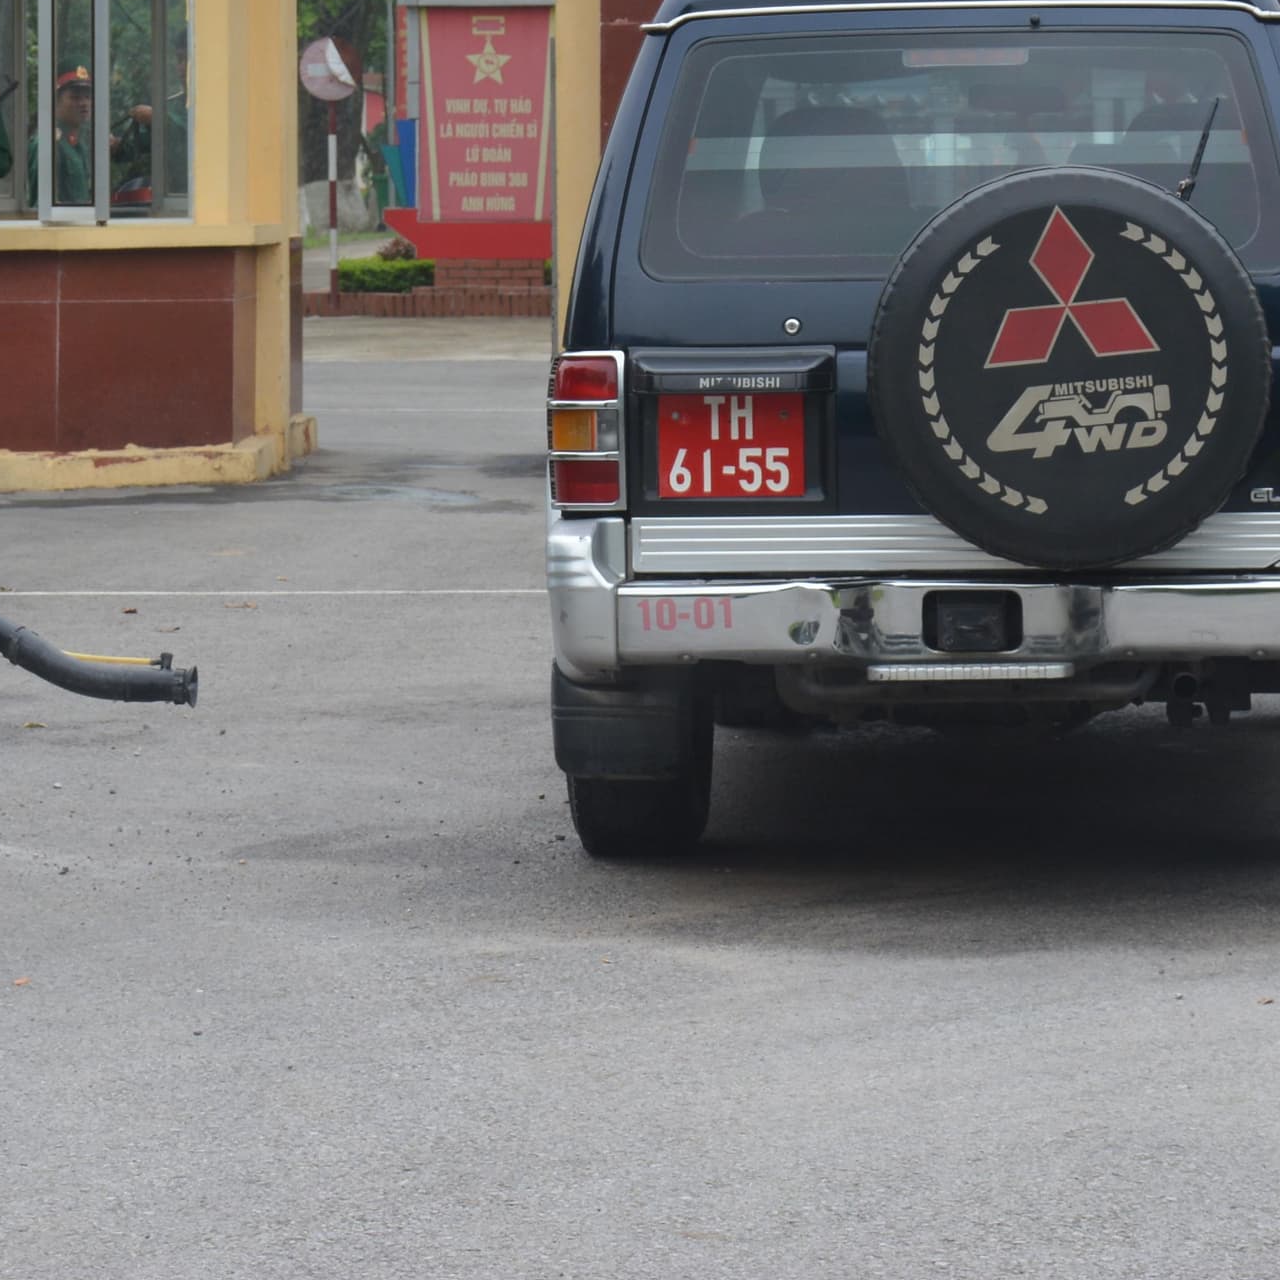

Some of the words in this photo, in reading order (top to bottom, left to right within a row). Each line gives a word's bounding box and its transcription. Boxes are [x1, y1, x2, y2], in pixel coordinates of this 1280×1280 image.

[699, 377, 780, 389] MITUBISHI
[1055, 375, 1153, 396] MITSUBISHI
[704, 395, 754, 440] TH
[986, 384, 1168, 459] 4WD
[669, 447, 790, 493] 61-55
[637, 597, 733, 631] 10-01
